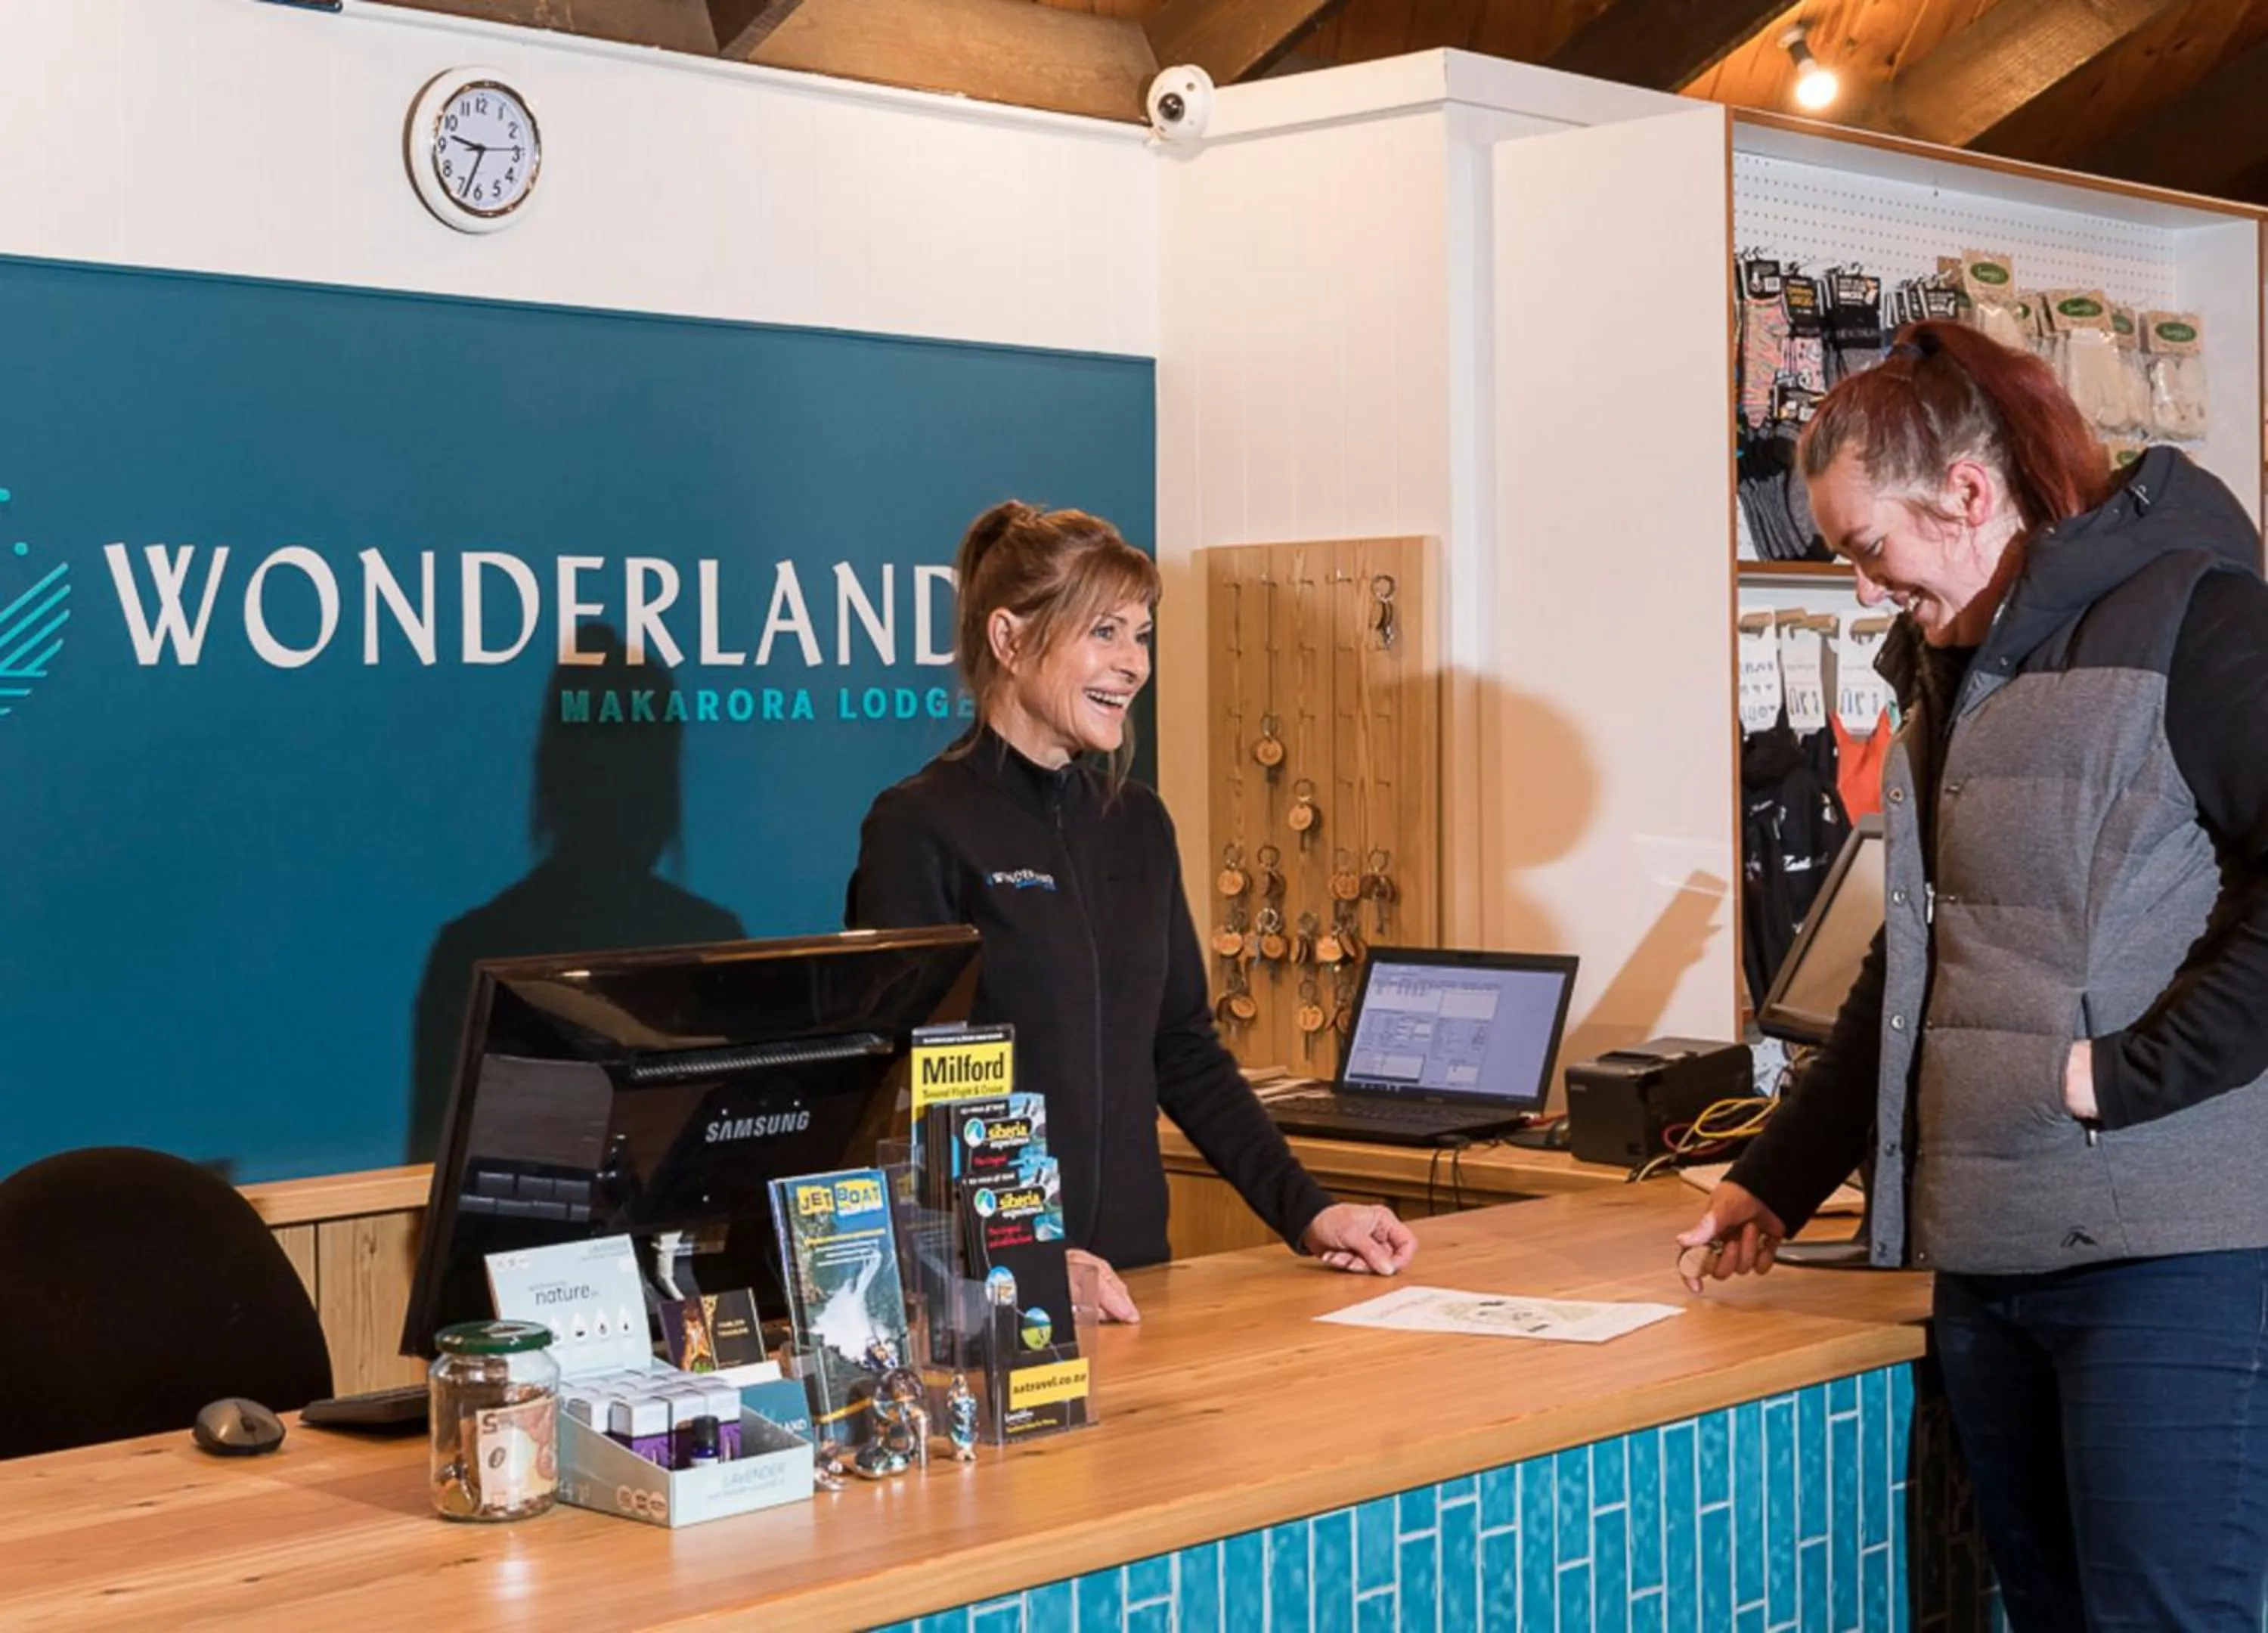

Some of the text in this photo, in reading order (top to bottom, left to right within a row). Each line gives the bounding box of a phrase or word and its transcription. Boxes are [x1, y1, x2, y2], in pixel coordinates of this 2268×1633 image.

[460, 101, 470, 116] 11
[476, 98, 488, 115] 12
[497, 104, 505, 120] 1
[445, 115, 458, 132] 10
[507, 122, 519, 139] 2
[438, 136, 447, 153] 9
[511, 146, 520, 163] 3
[443, 160, 452, 177] 8
[505, 166, 515, 183] 4
[457, 177, 465, 193] 7
[473, 184, 482, 201] 6
[492, 180, 502, 197] 5
[103, 542, 960, 668] WONDERLAND
[561, 688, 815, 724] MAKARORA
[922, 1052, 1004, 1084] Milford
[705, 1110, 810, 1143] SAMSUNG
[802, 1185, 880, 1210] JET BOAT
[535, 1284, 590, 1306] nature
